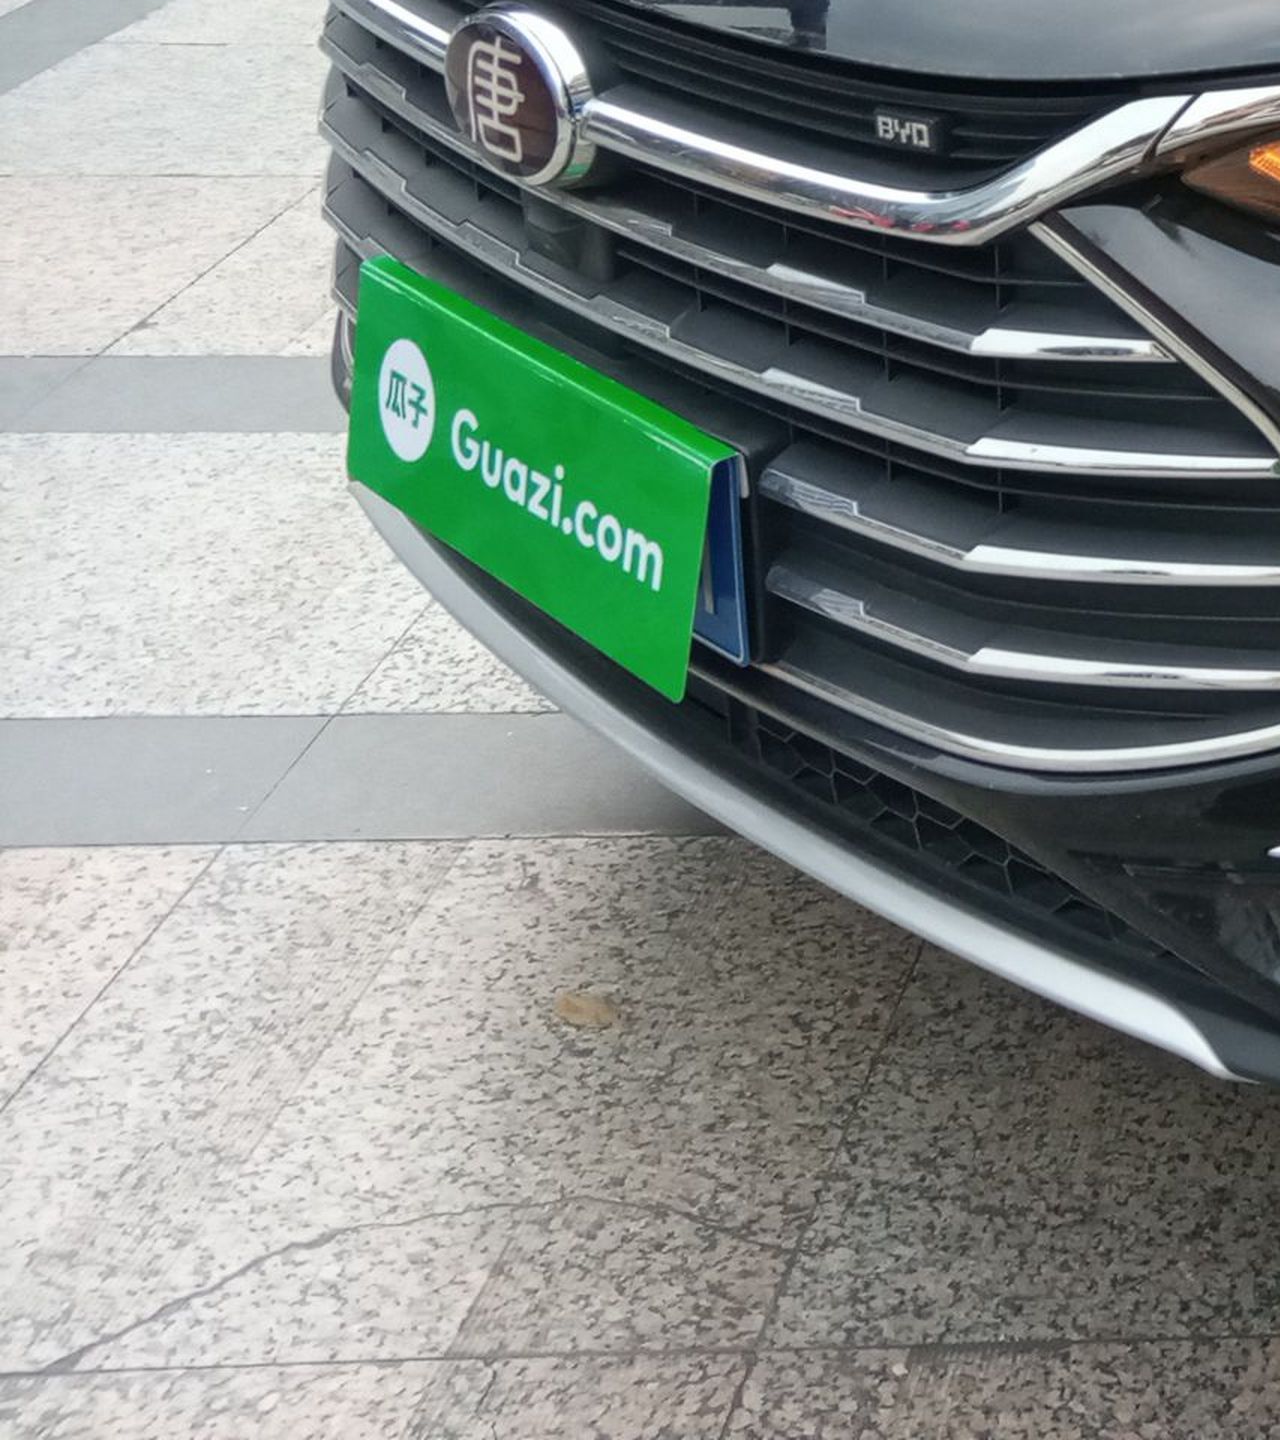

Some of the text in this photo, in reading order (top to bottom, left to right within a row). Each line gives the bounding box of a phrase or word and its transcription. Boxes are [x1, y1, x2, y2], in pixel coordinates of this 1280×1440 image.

[877, 115, 930, 148] BYD
[386, 370, 428, 429] 瓜子
[451, 408, 664, 592] Guazi.com
